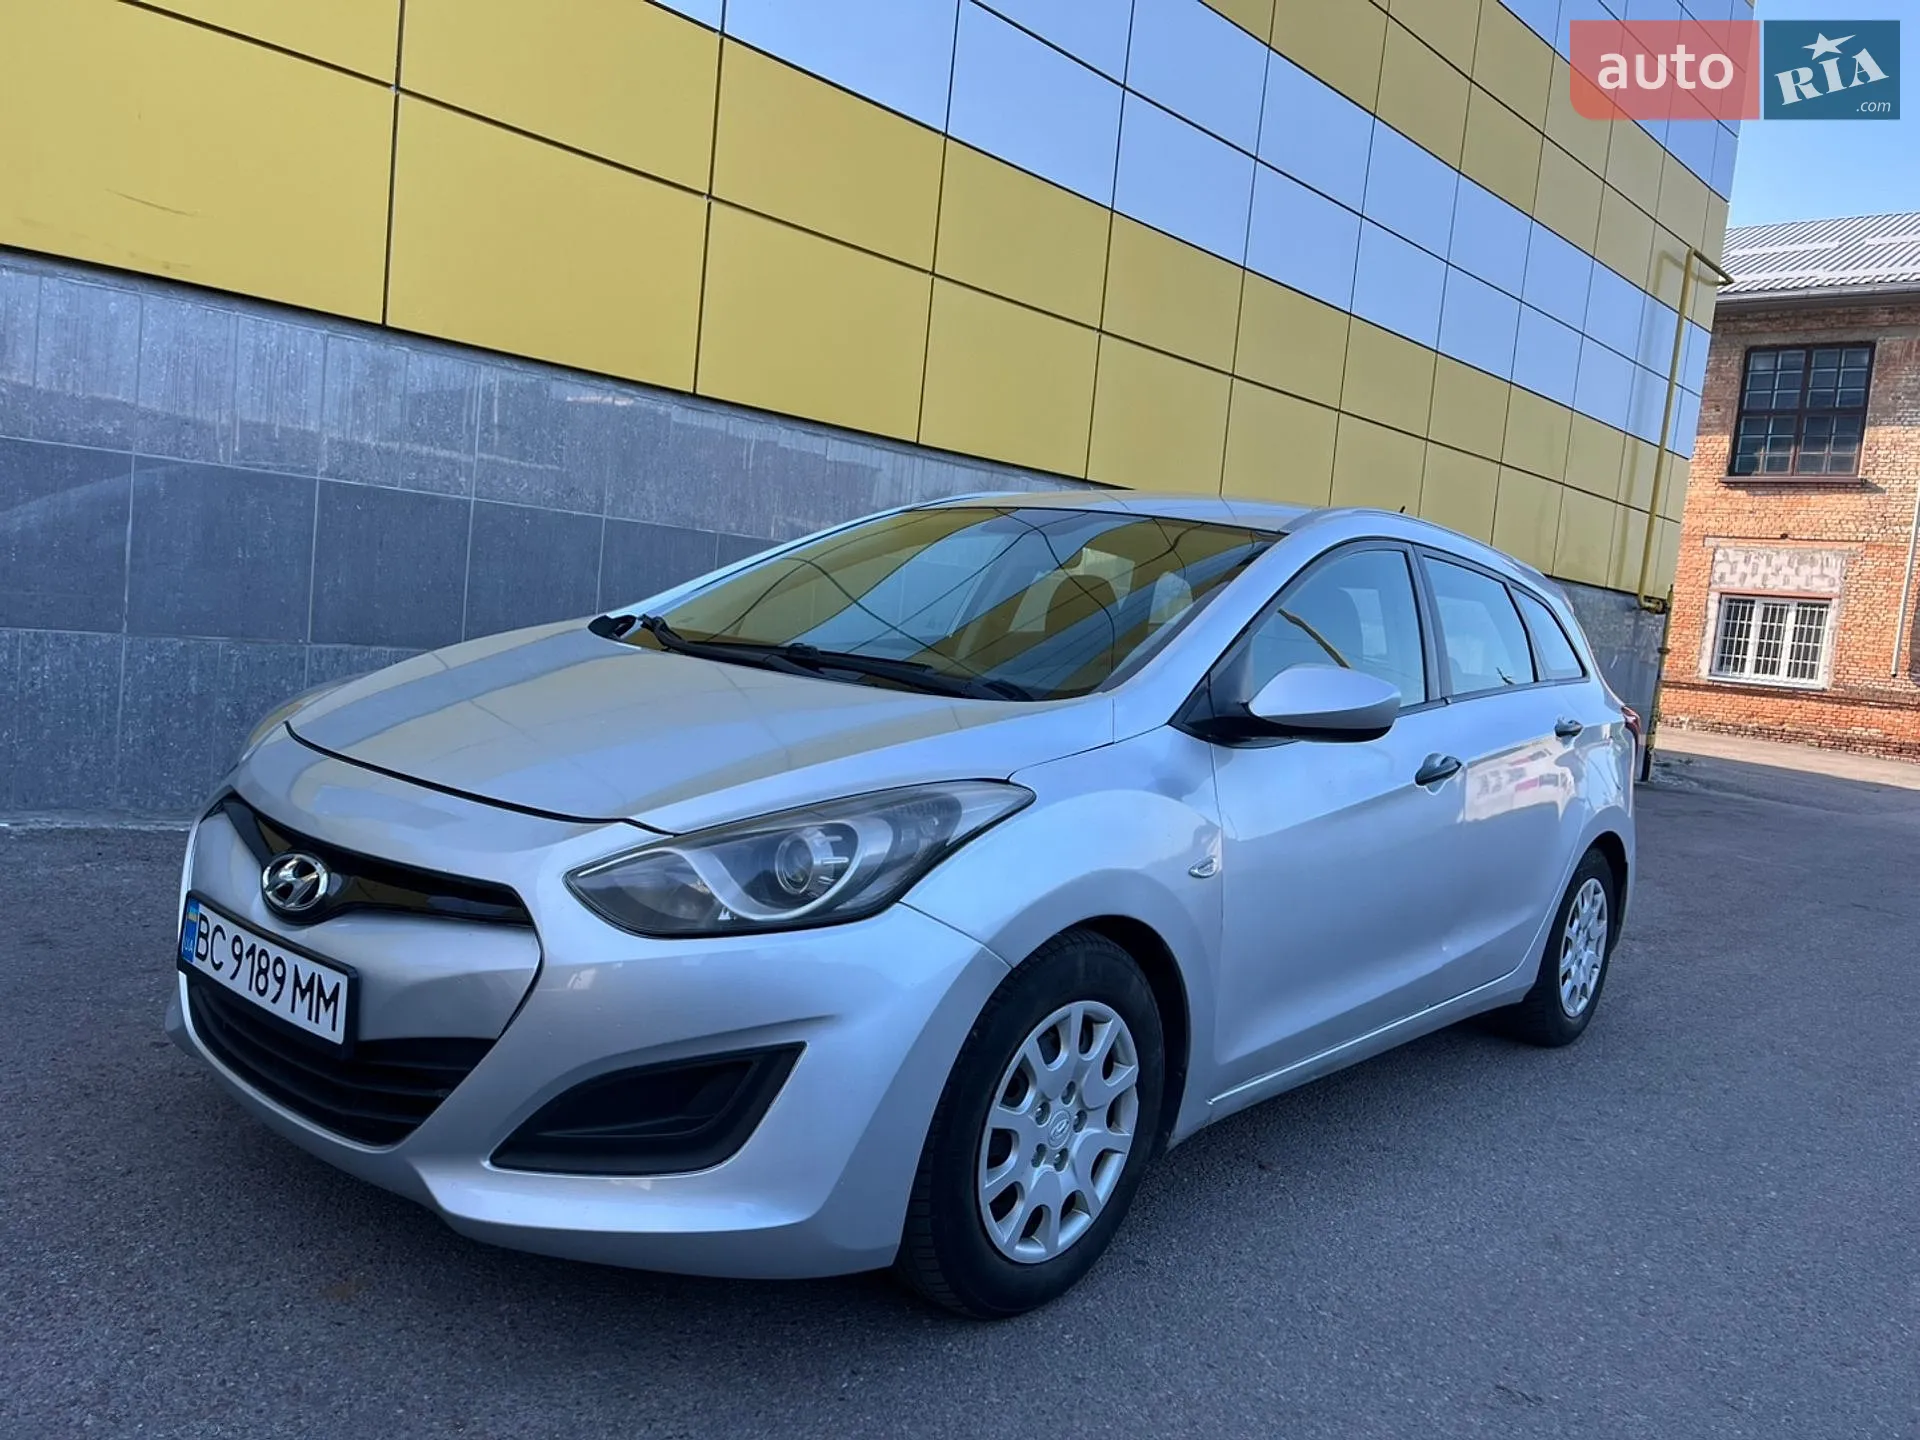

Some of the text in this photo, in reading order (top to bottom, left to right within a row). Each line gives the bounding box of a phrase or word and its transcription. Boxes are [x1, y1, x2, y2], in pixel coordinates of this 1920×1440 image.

[195, 913, 341, 1033] BC 9189 MM
